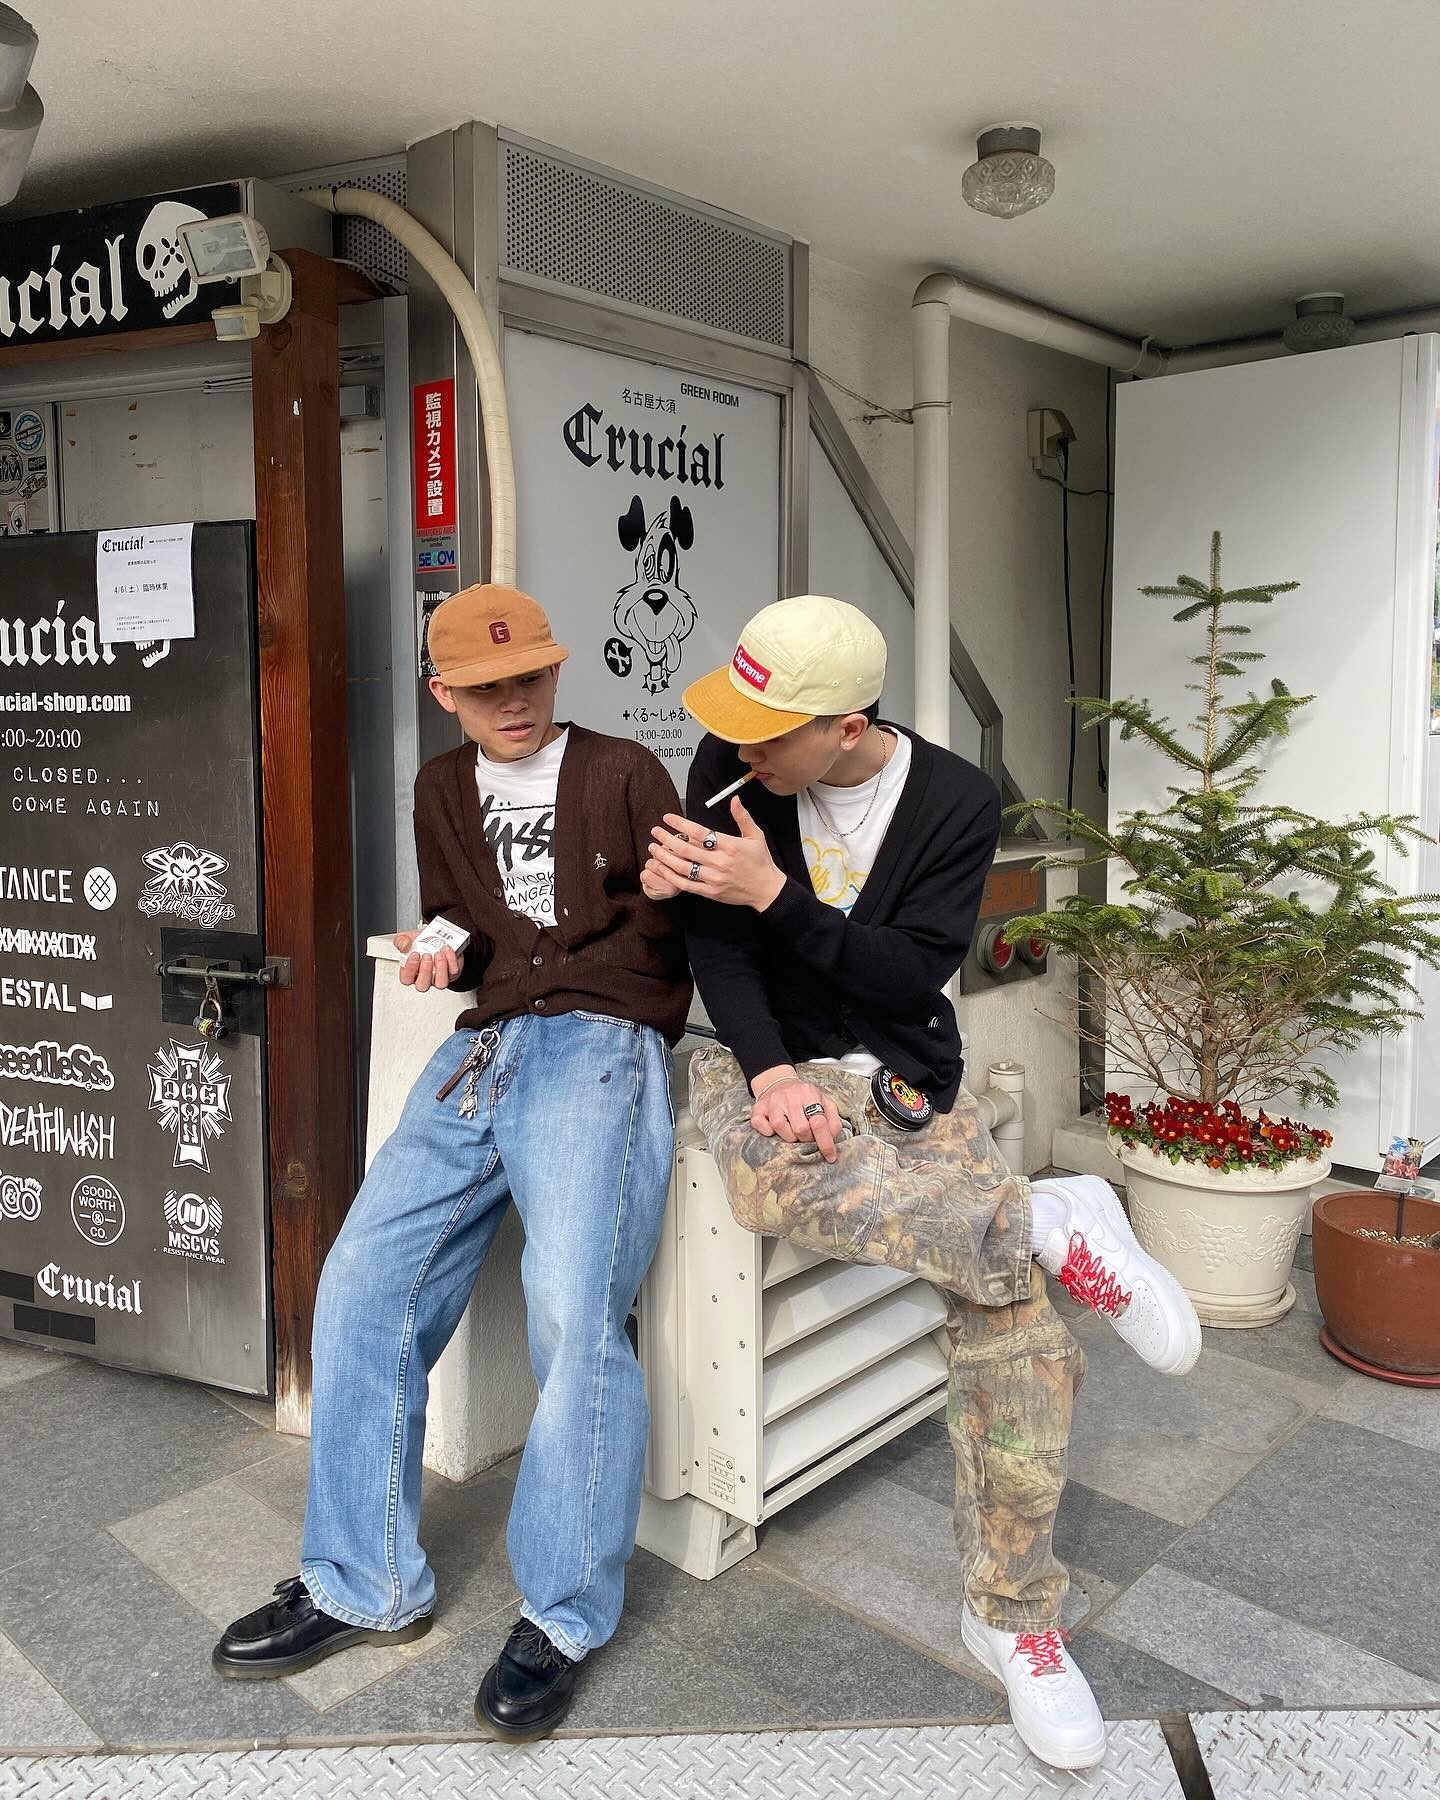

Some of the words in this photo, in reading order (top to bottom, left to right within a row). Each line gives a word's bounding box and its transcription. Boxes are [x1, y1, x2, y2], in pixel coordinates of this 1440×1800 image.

[622, 388, 677, 415] 名古屋大須
[680, 383, 711, 401] GREEN
[712, 390, 740, 408] ROOM
[425, 392, 443, 517] 監視カメラ設置
[563, 402, 725, 491] Crucial
[102, 536, 144, 553] Crucial
[418, 550, 455, 567] SECOM
[735, 650, 766, 684] Supreme
[652, 745, 693, 759] shop.com
[12, 796, 67, 814] COME
[86, 799, 160, 817] AGAIN
[1, 977, 77, 1013] ESTAL
[79, 1195, 117, 1212] WORTH
[81, 1184, 117, 1200] GOOD-
[90, 1226, 108, 1239] CO.
[168, 1230, 220, 1256] MSCVS
[163, 1247, 204, 1261] RESISTANCE
[205, 1254, 226, 1265] WEAR
[37, 1262, 143, 1315] Crucial
